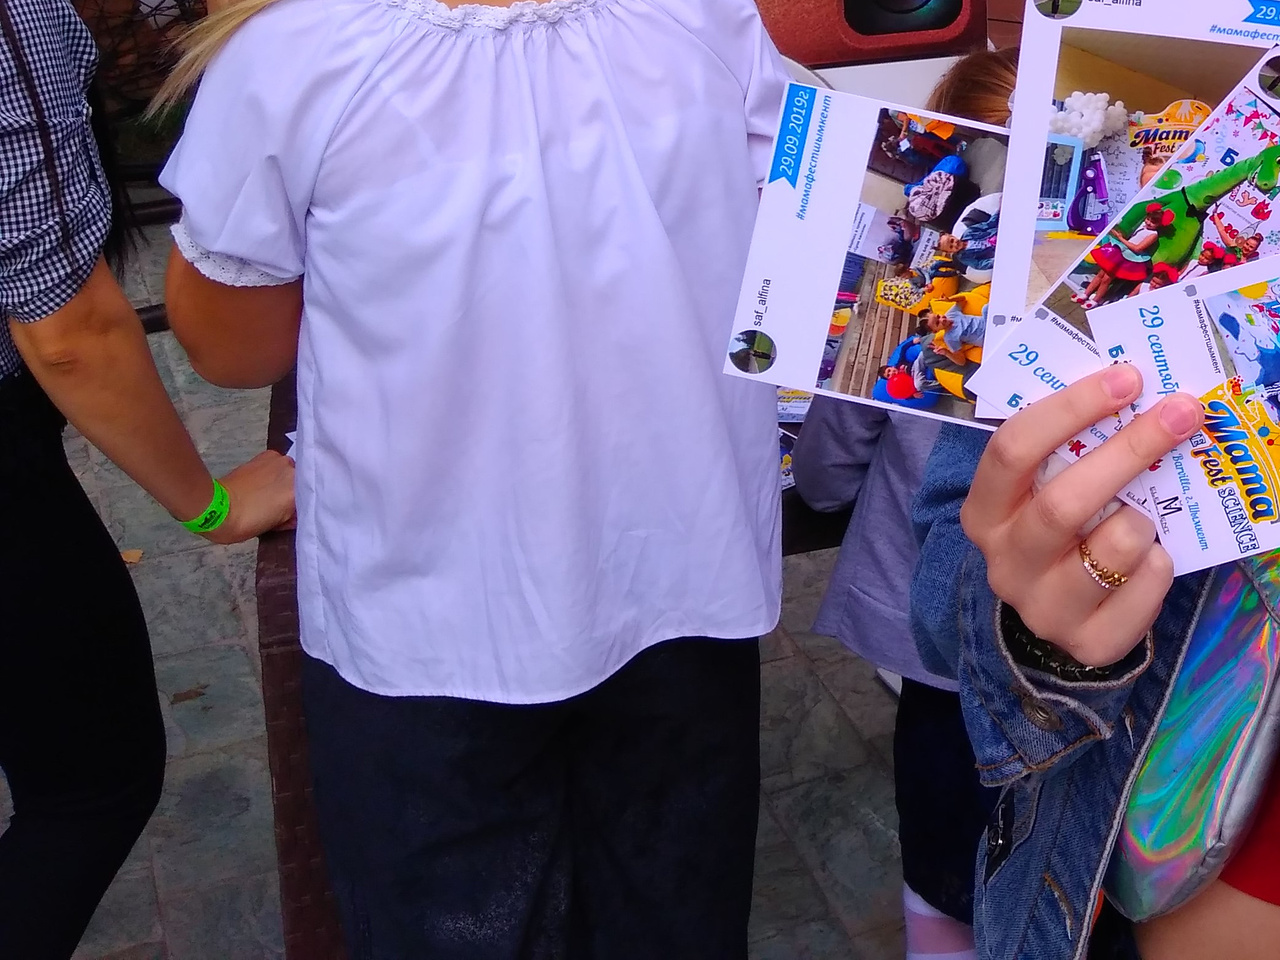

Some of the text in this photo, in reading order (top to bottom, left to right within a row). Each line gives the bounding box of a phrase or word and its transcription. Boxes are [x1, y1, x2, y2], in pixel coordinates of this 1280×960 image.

[779, 90, 810, 176] 29.09.2019г.
[796, 94, 832, 221] #мамафестшымкент
[753, 278, 772, 327] saf_alfina
[1138, 305, 1164, 329] 29
[1008, 343, 1039, 366] 29
[1193, 299, 1222, 374] #мамафестшымкент
[1172, 452, 1191, 495] Barvilla,
[1192, 444, 1233, 486] Fest
[1218, 486, 1260, 554] SCIENCE
